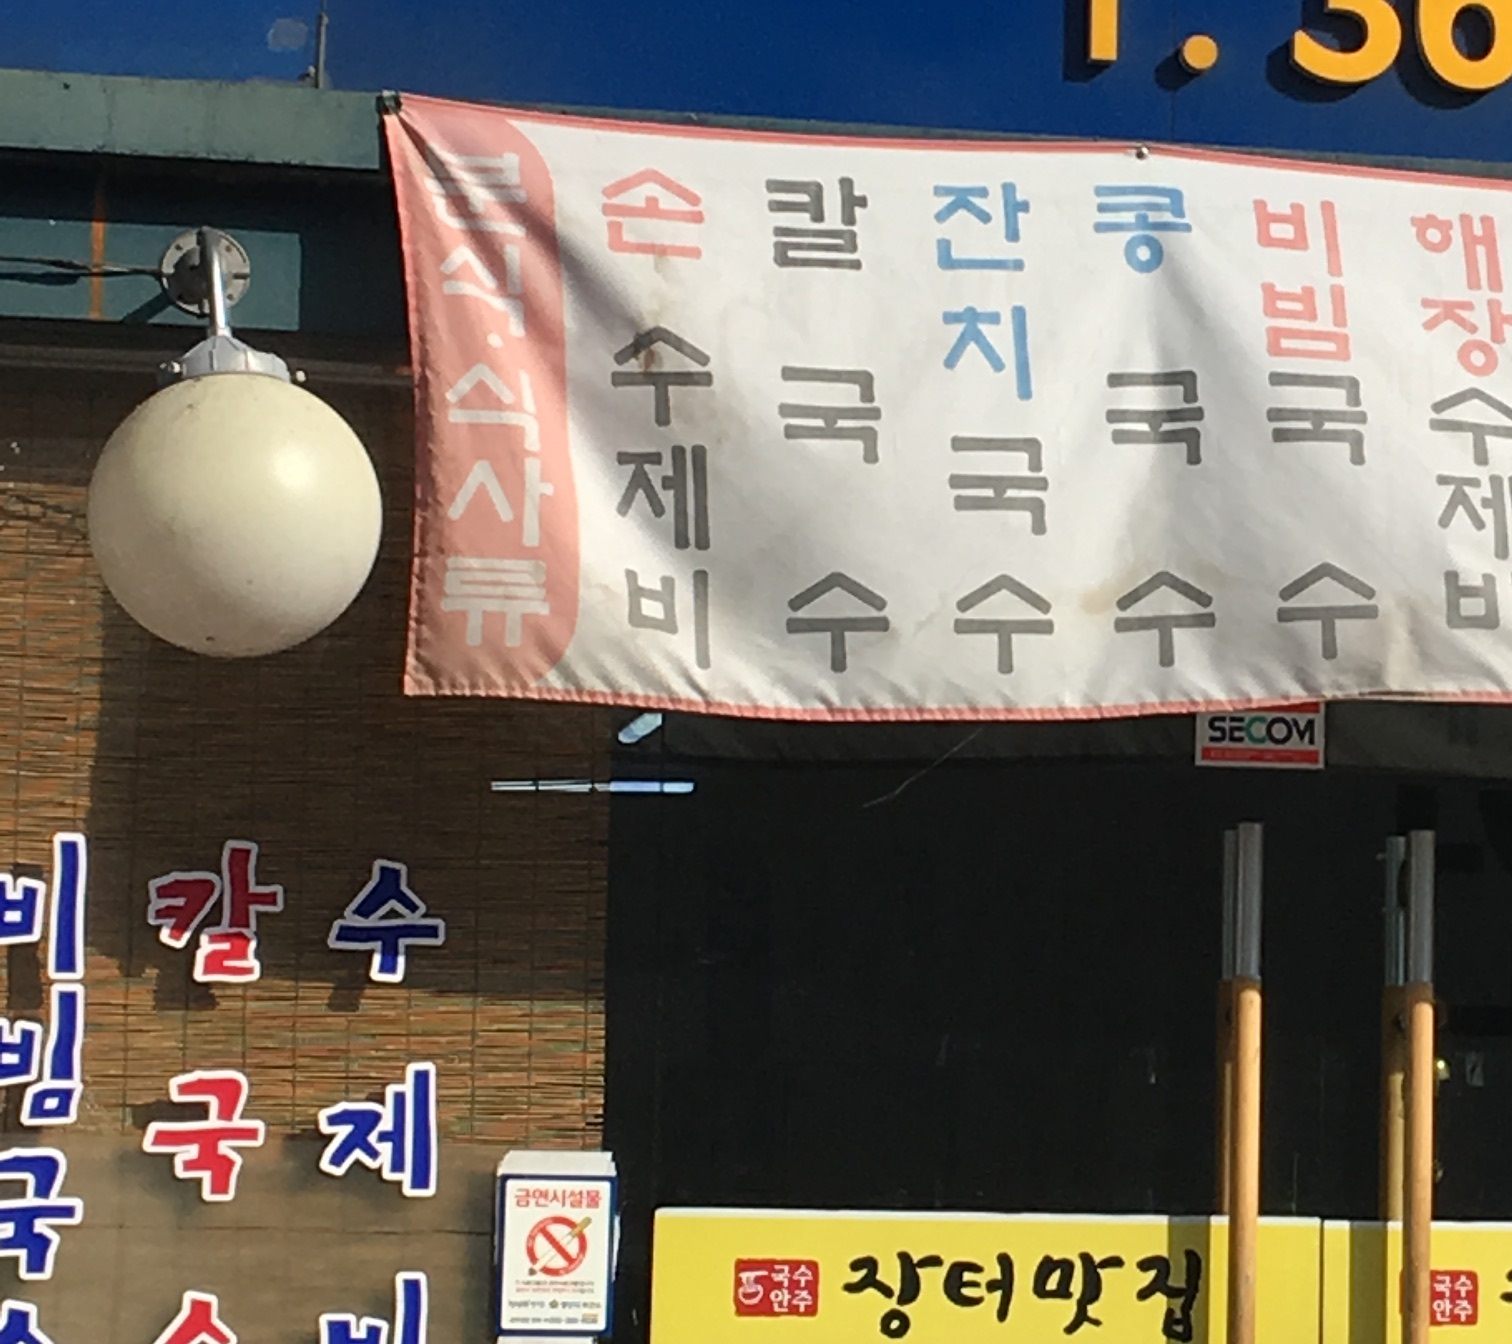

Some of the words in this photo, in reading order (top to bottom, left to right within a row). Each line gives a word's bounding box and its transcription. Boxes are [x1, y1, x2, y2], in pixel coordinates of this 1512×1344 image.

[766, 177, 889, 672] 칼국수
[933, 182, 1054, 674] 잔치국수
[1093, 185, 1216, 668] 콩국수
[1253, 200, 1379, 660] 비빔국수
[1208, 716, 1315, 745] SECOM
[842, 1250, 1203, 1344] 장터맛집
